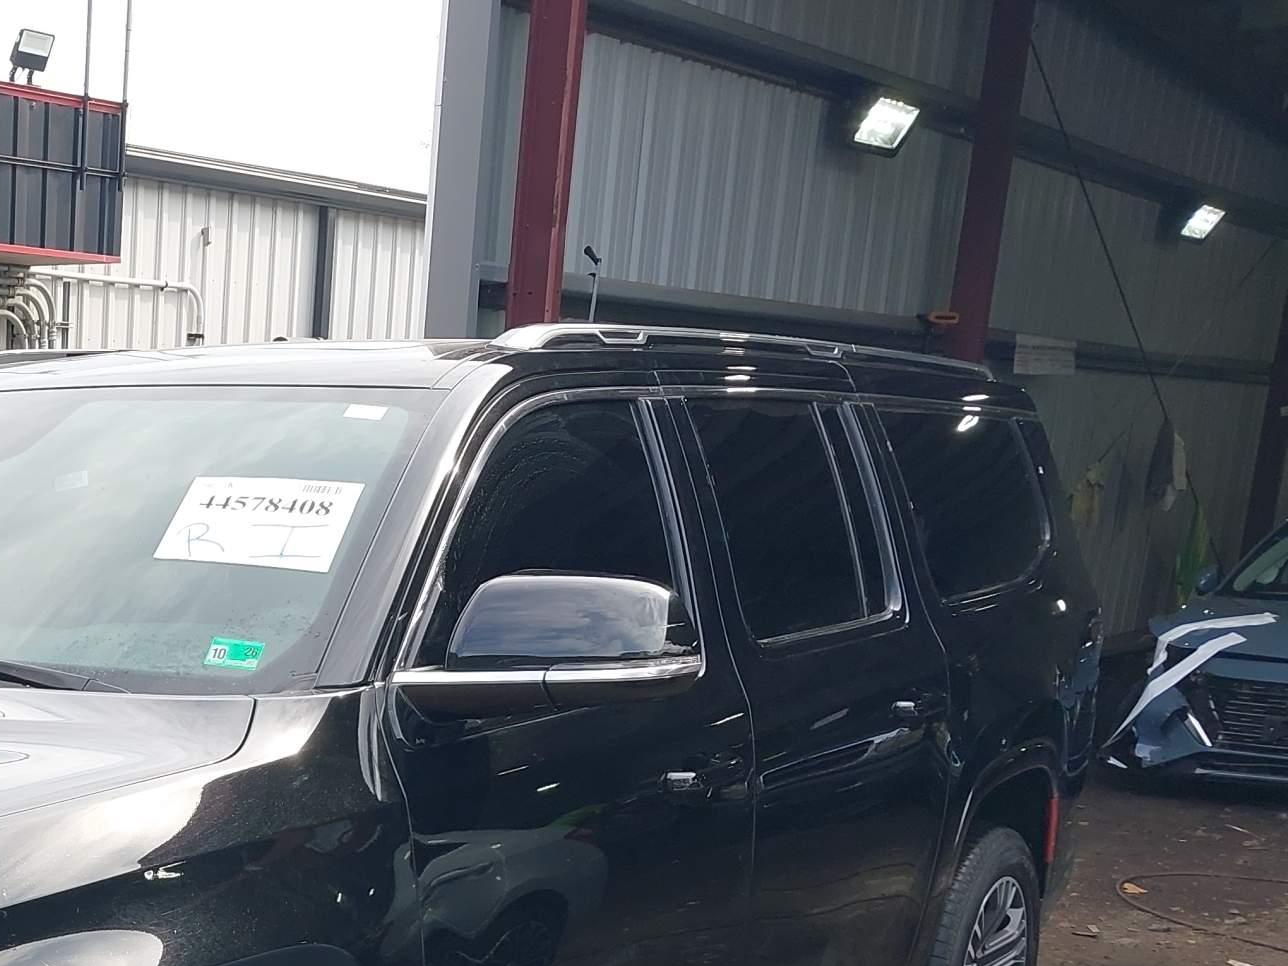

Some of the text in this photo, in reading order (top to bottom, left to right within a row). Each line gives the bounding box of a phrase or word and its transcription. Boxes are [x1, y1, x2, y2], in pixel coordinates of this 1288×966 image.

[199, 495, 333, 516] 44578408
[176, 522, 225, 558] R
[212, 647, 227, 660] 10
